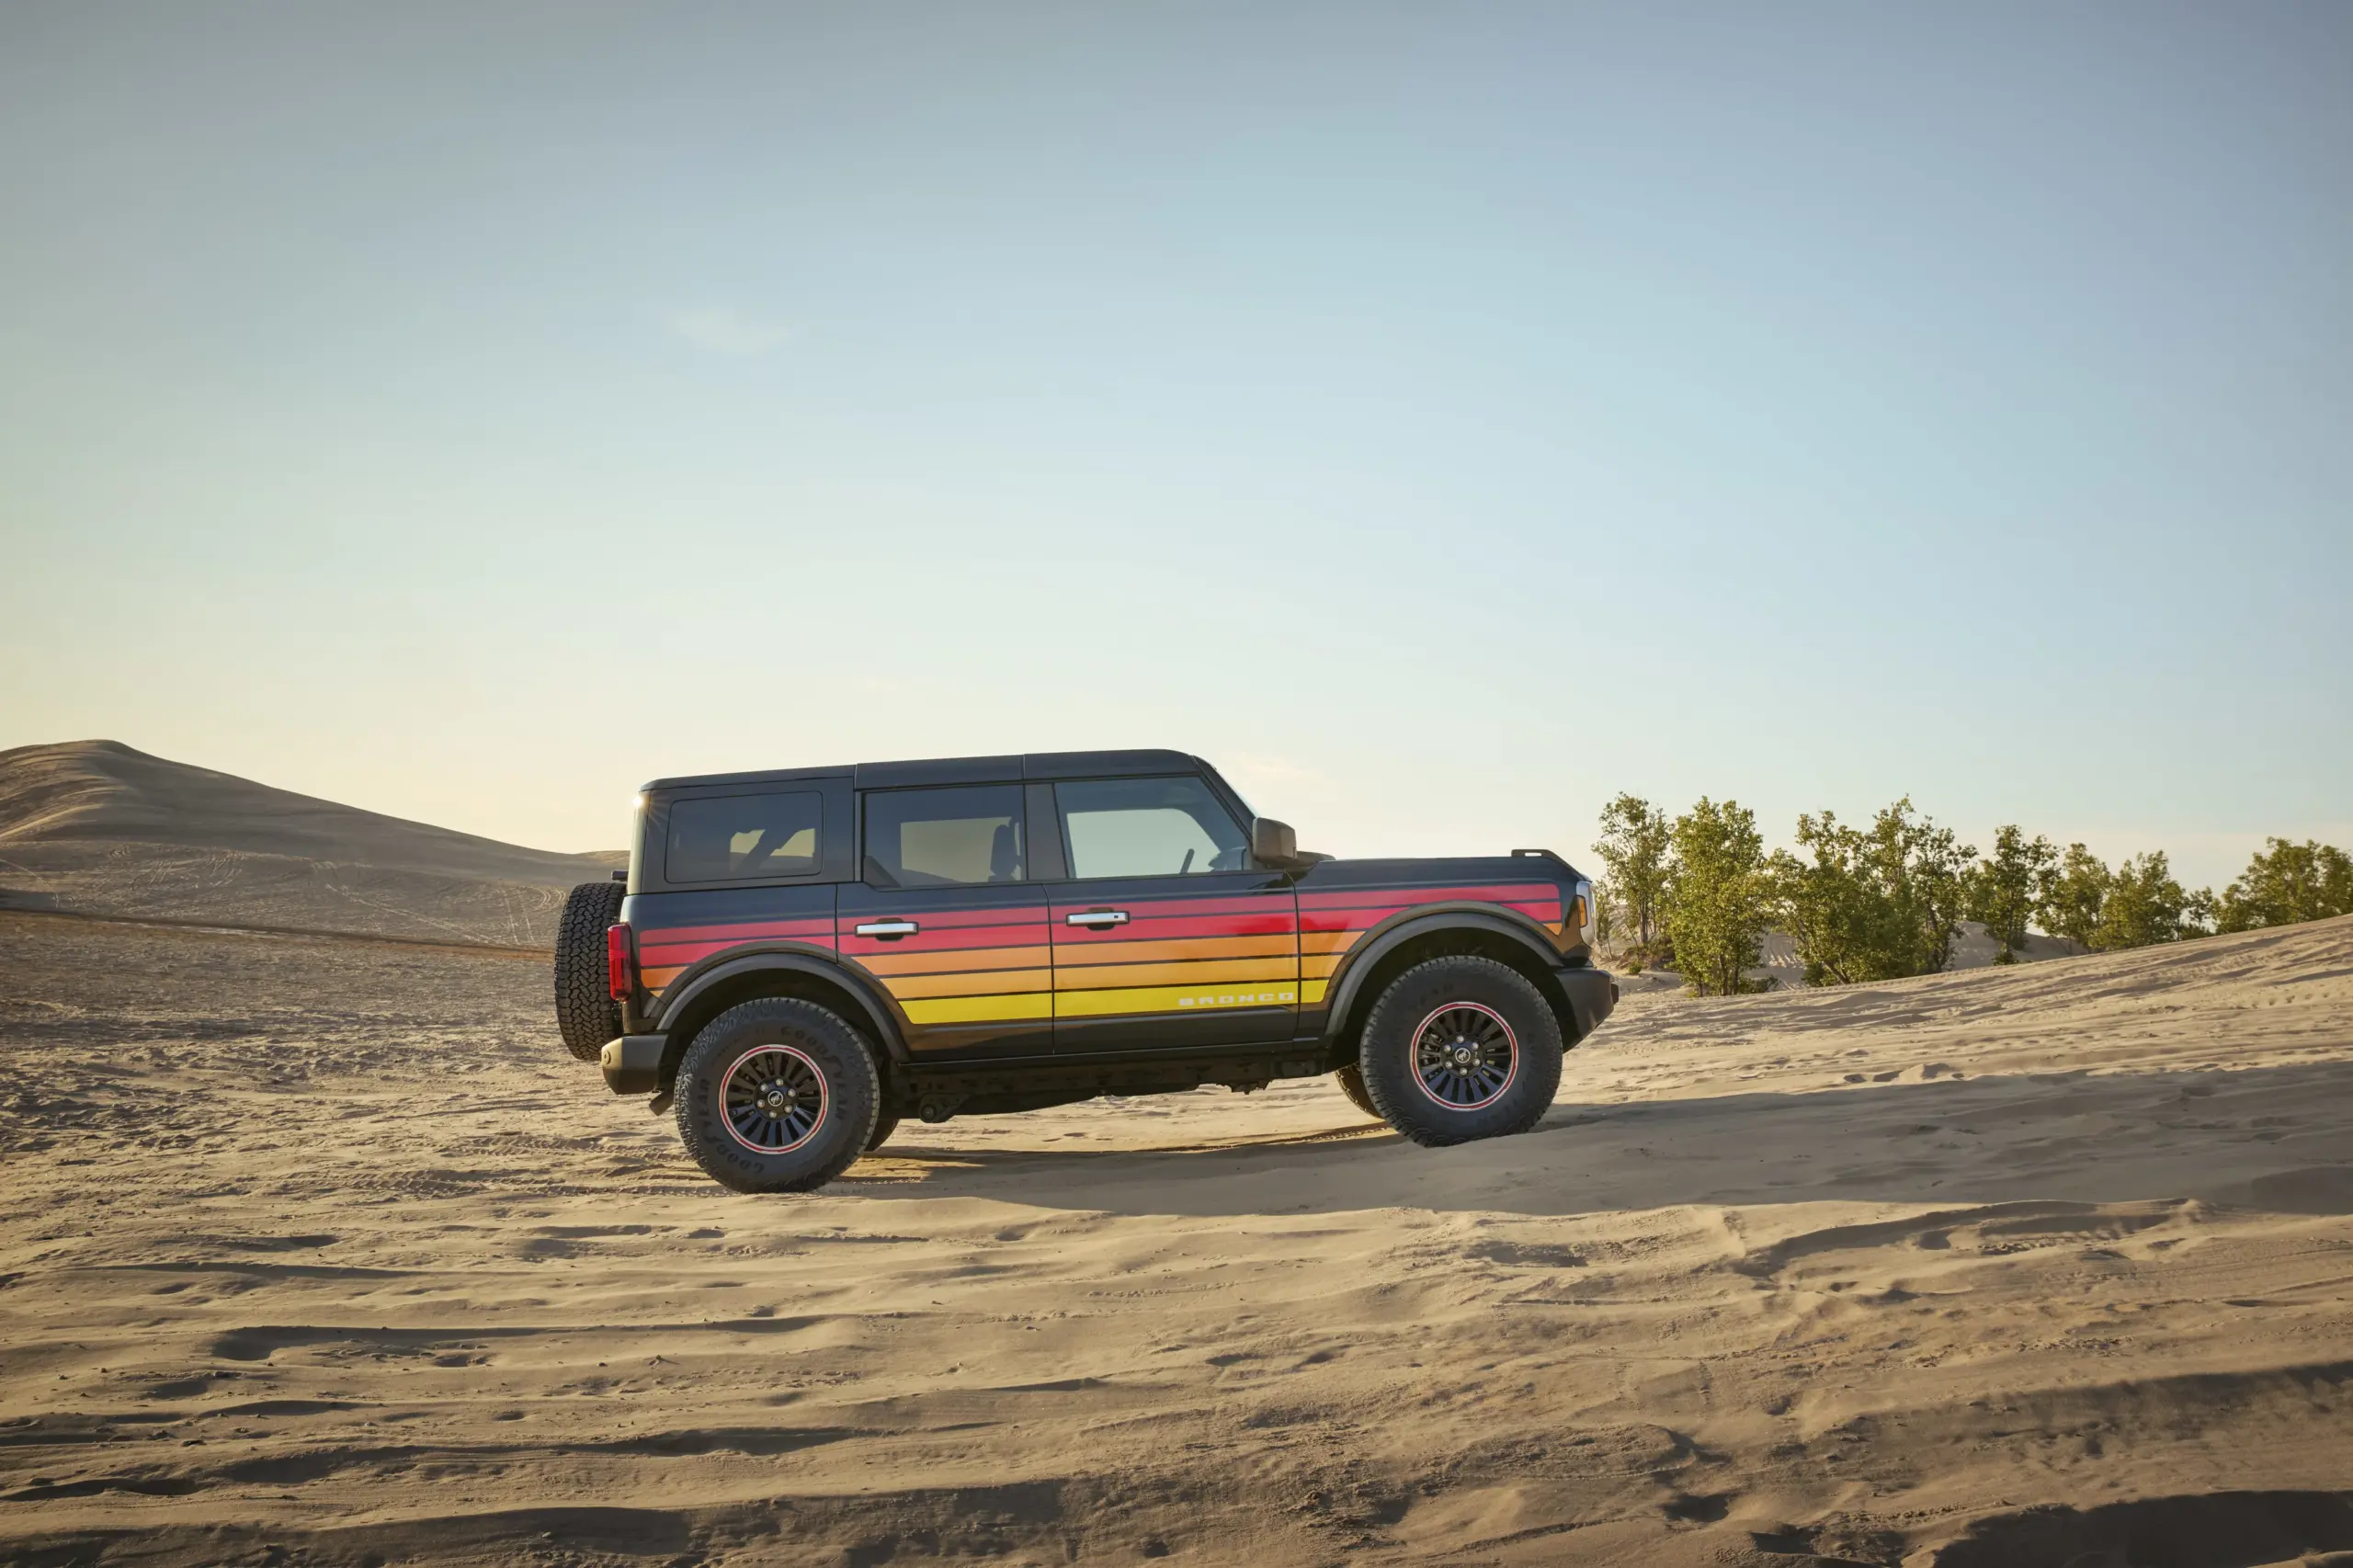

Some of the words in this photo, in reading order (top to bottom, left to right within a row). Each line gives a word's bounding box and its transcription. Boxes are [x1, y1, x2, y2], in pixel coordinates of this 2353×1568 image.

[1178, 992, 1294, 1006] BRONCO
[780, 1026, 848, 1120] GOODYEAR
[698, 1078, 765, 1174] GOODYEAR
